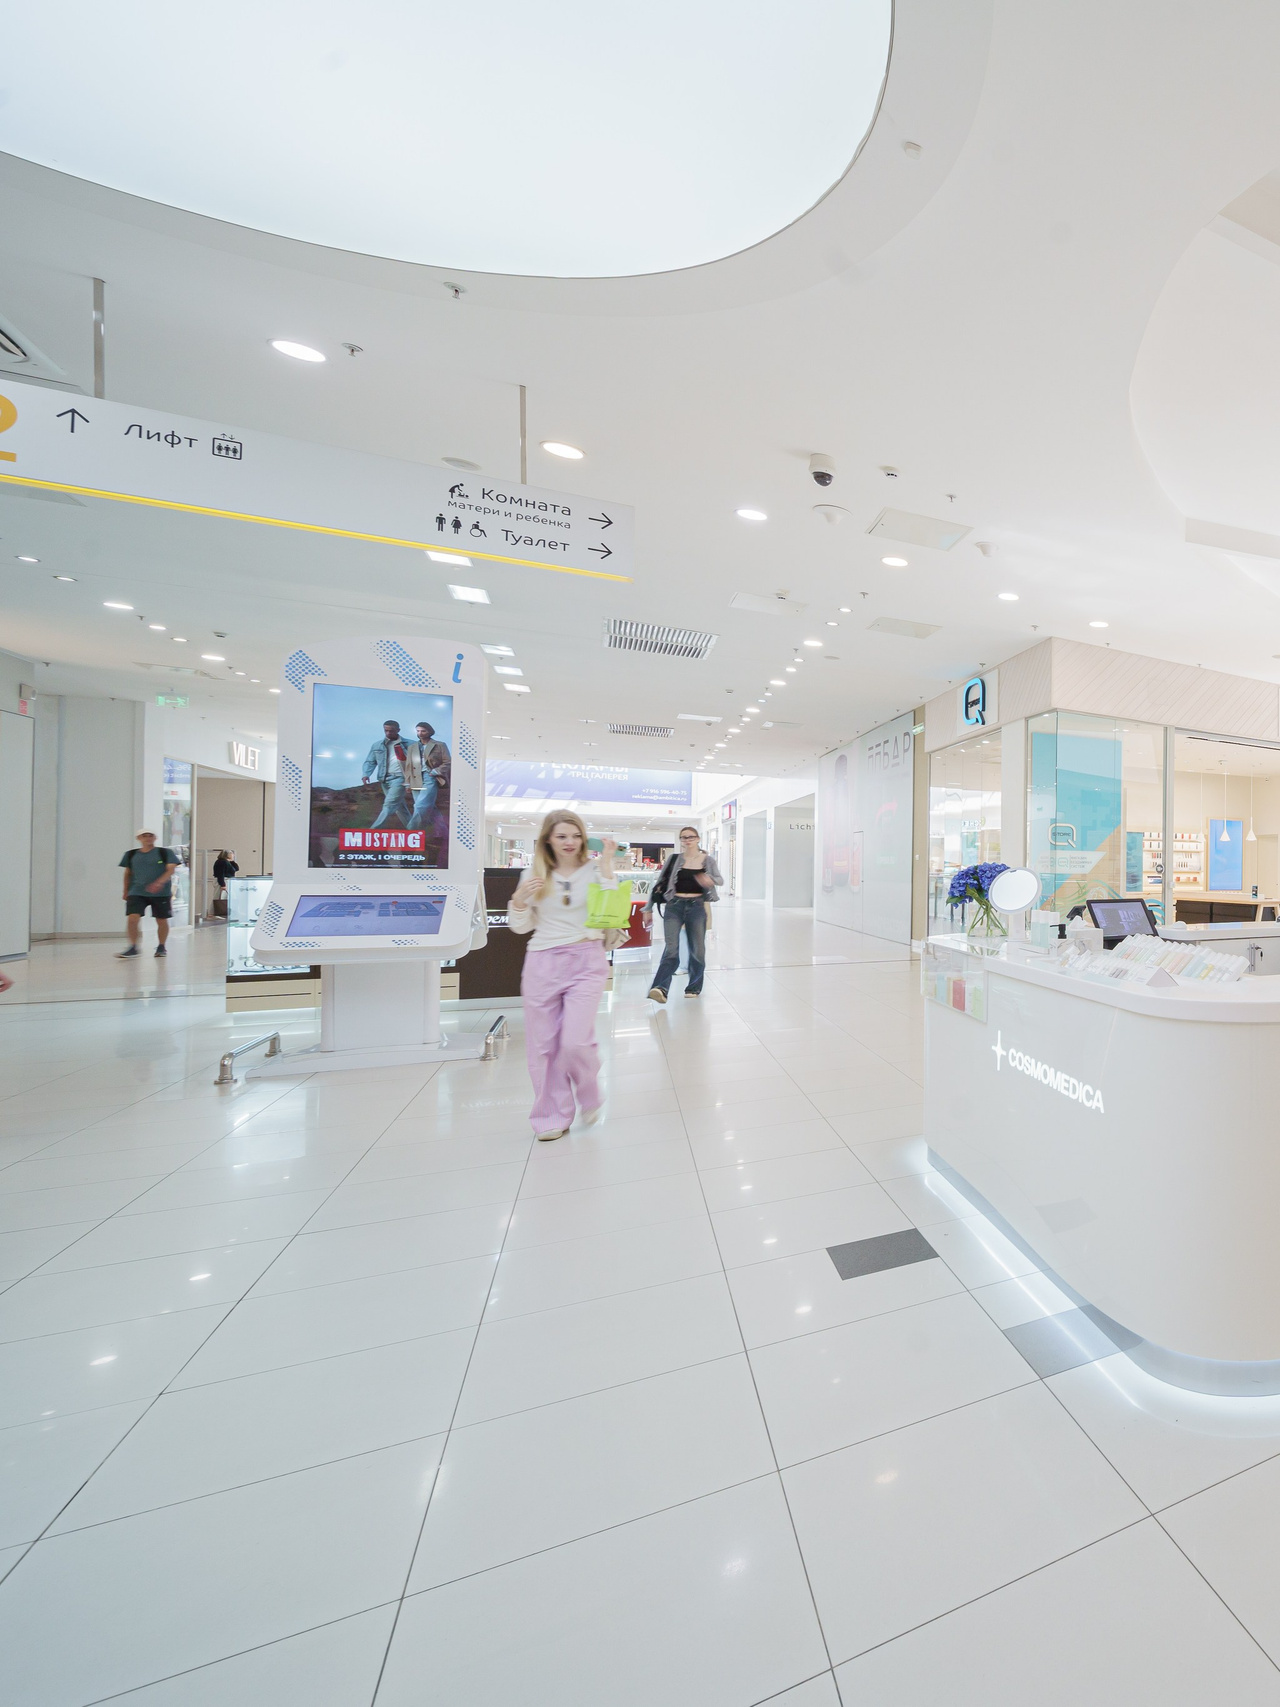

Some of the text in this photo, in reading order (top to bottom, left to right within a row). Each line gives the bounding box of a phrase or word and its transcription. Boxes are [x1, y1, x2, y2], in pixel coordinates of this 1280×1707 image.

[124, 424, 199, 448] Лифт
[481, 487, 572, 516] Комната
[447, 500, 571, 530] матери и ребенка
[501, 528, 570, 552] Туалет
[571, 770, 629, 781] ТРЦ ГАЛЕРЕЯ
[344, 831, 421, 848] MUSTANG
[383, 854, 426, 862] ОЧЕРЕДЬ
[1008, 1047, 1105, 1114] COSMOMEDICA
